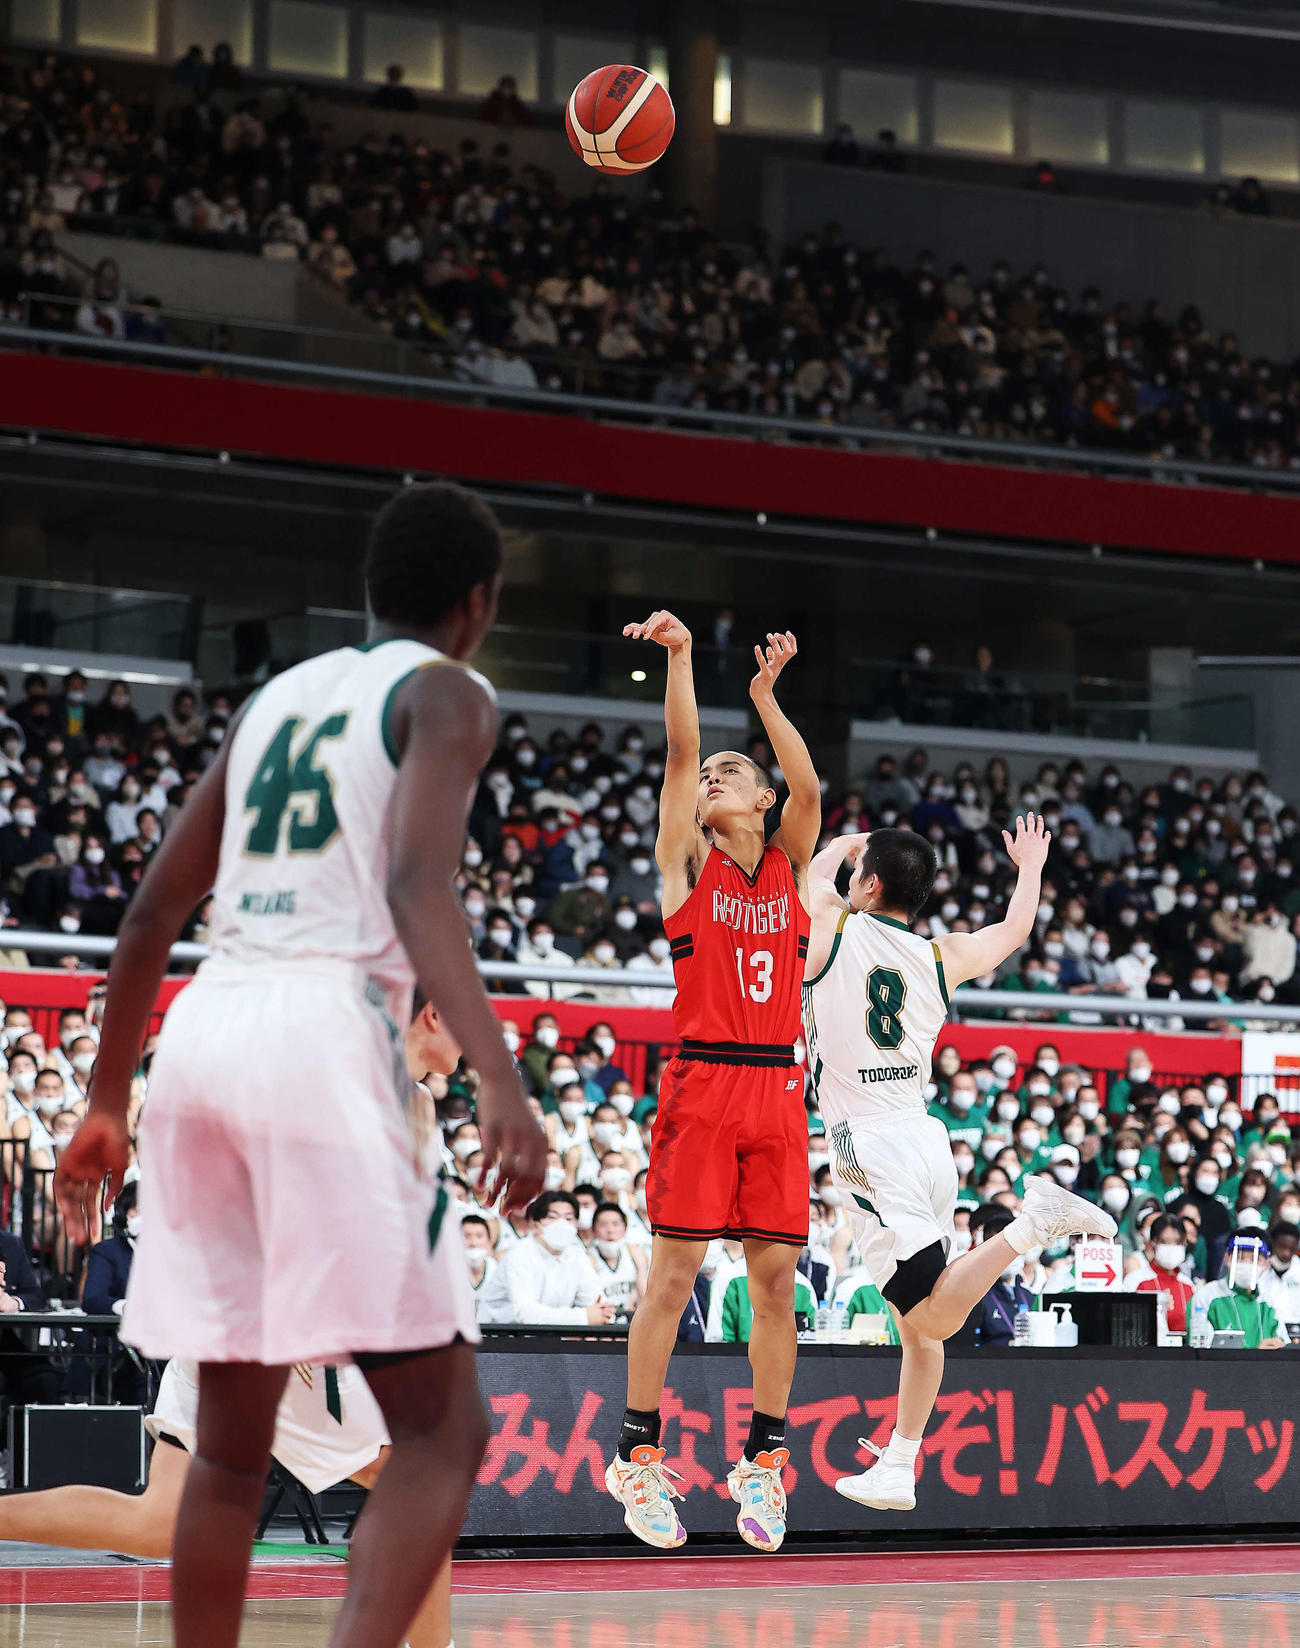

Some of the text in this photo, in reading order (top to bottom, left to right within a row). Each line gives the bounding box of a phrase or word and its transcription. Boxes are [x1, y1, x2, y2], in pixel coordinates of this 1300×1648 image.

[241, 711, 350, 859] 45
[735, 947, 774, 1004] 13
[866, 964, 908, 1051] 8
[1083, 1247, 1113, 1261] POSS
